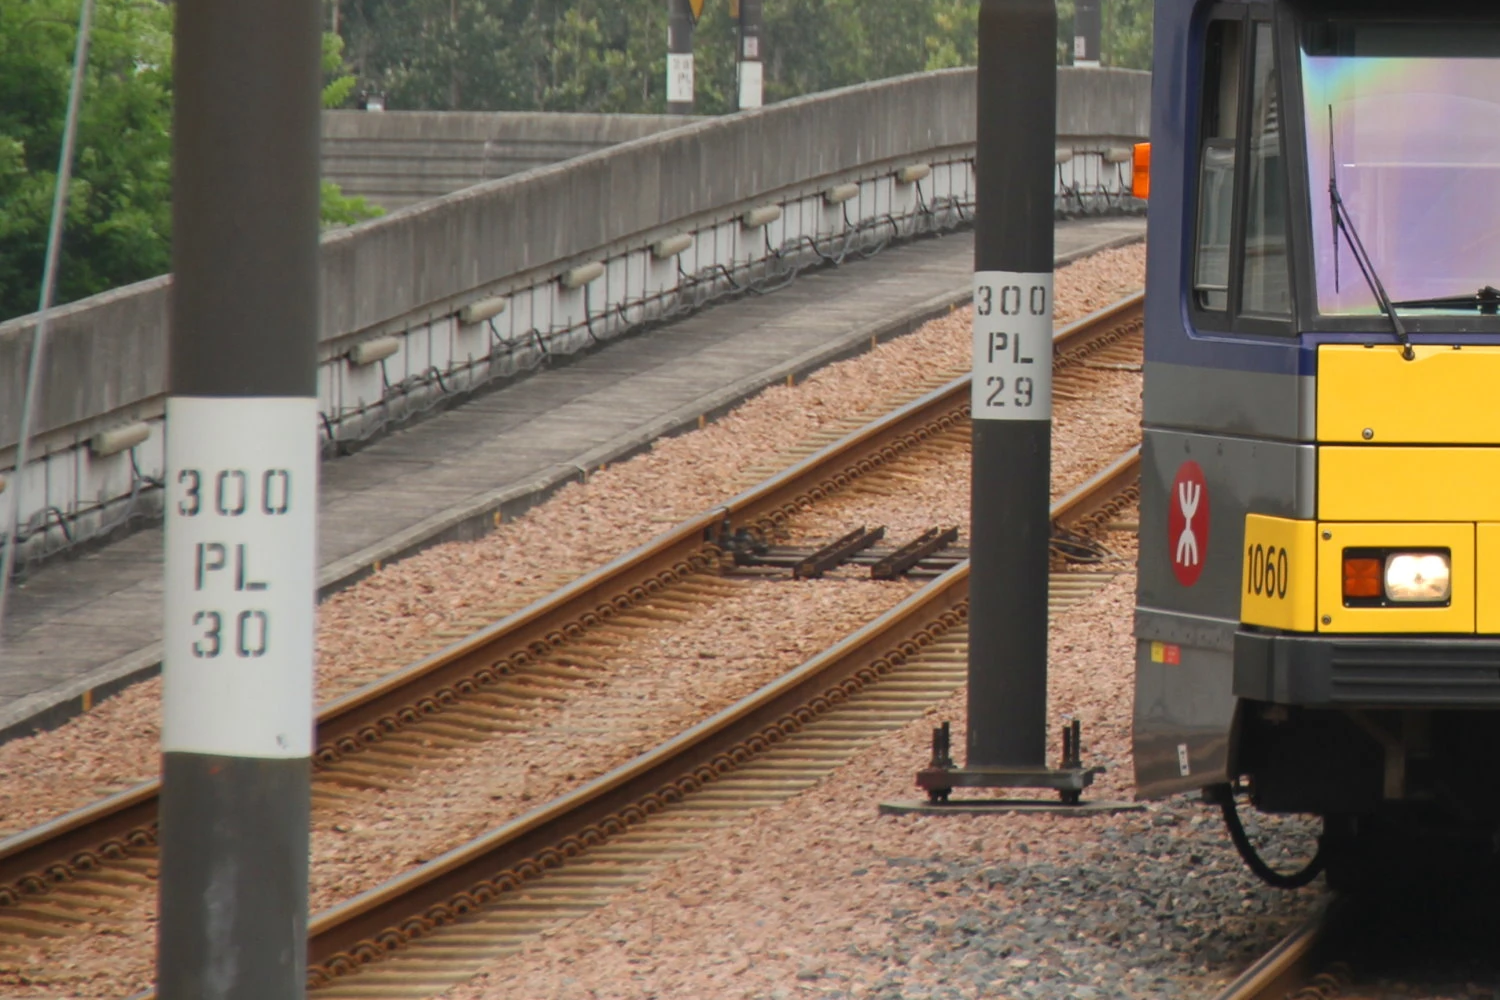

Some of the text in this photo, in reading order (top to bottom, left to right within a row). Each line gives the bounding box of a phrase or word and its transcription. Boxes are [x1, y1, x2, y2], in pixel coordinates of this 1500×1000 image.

[977, 285, 1046, 316] 300
[988, 332, 1034, 365] PL
[986, 376, 1034, 408] 29
[177, 468, 290, 517] 300
[194, 542, 268, 592] PL
[1247, 543, 1288, 600] 1060
[191, 610, 268, 659] 30
